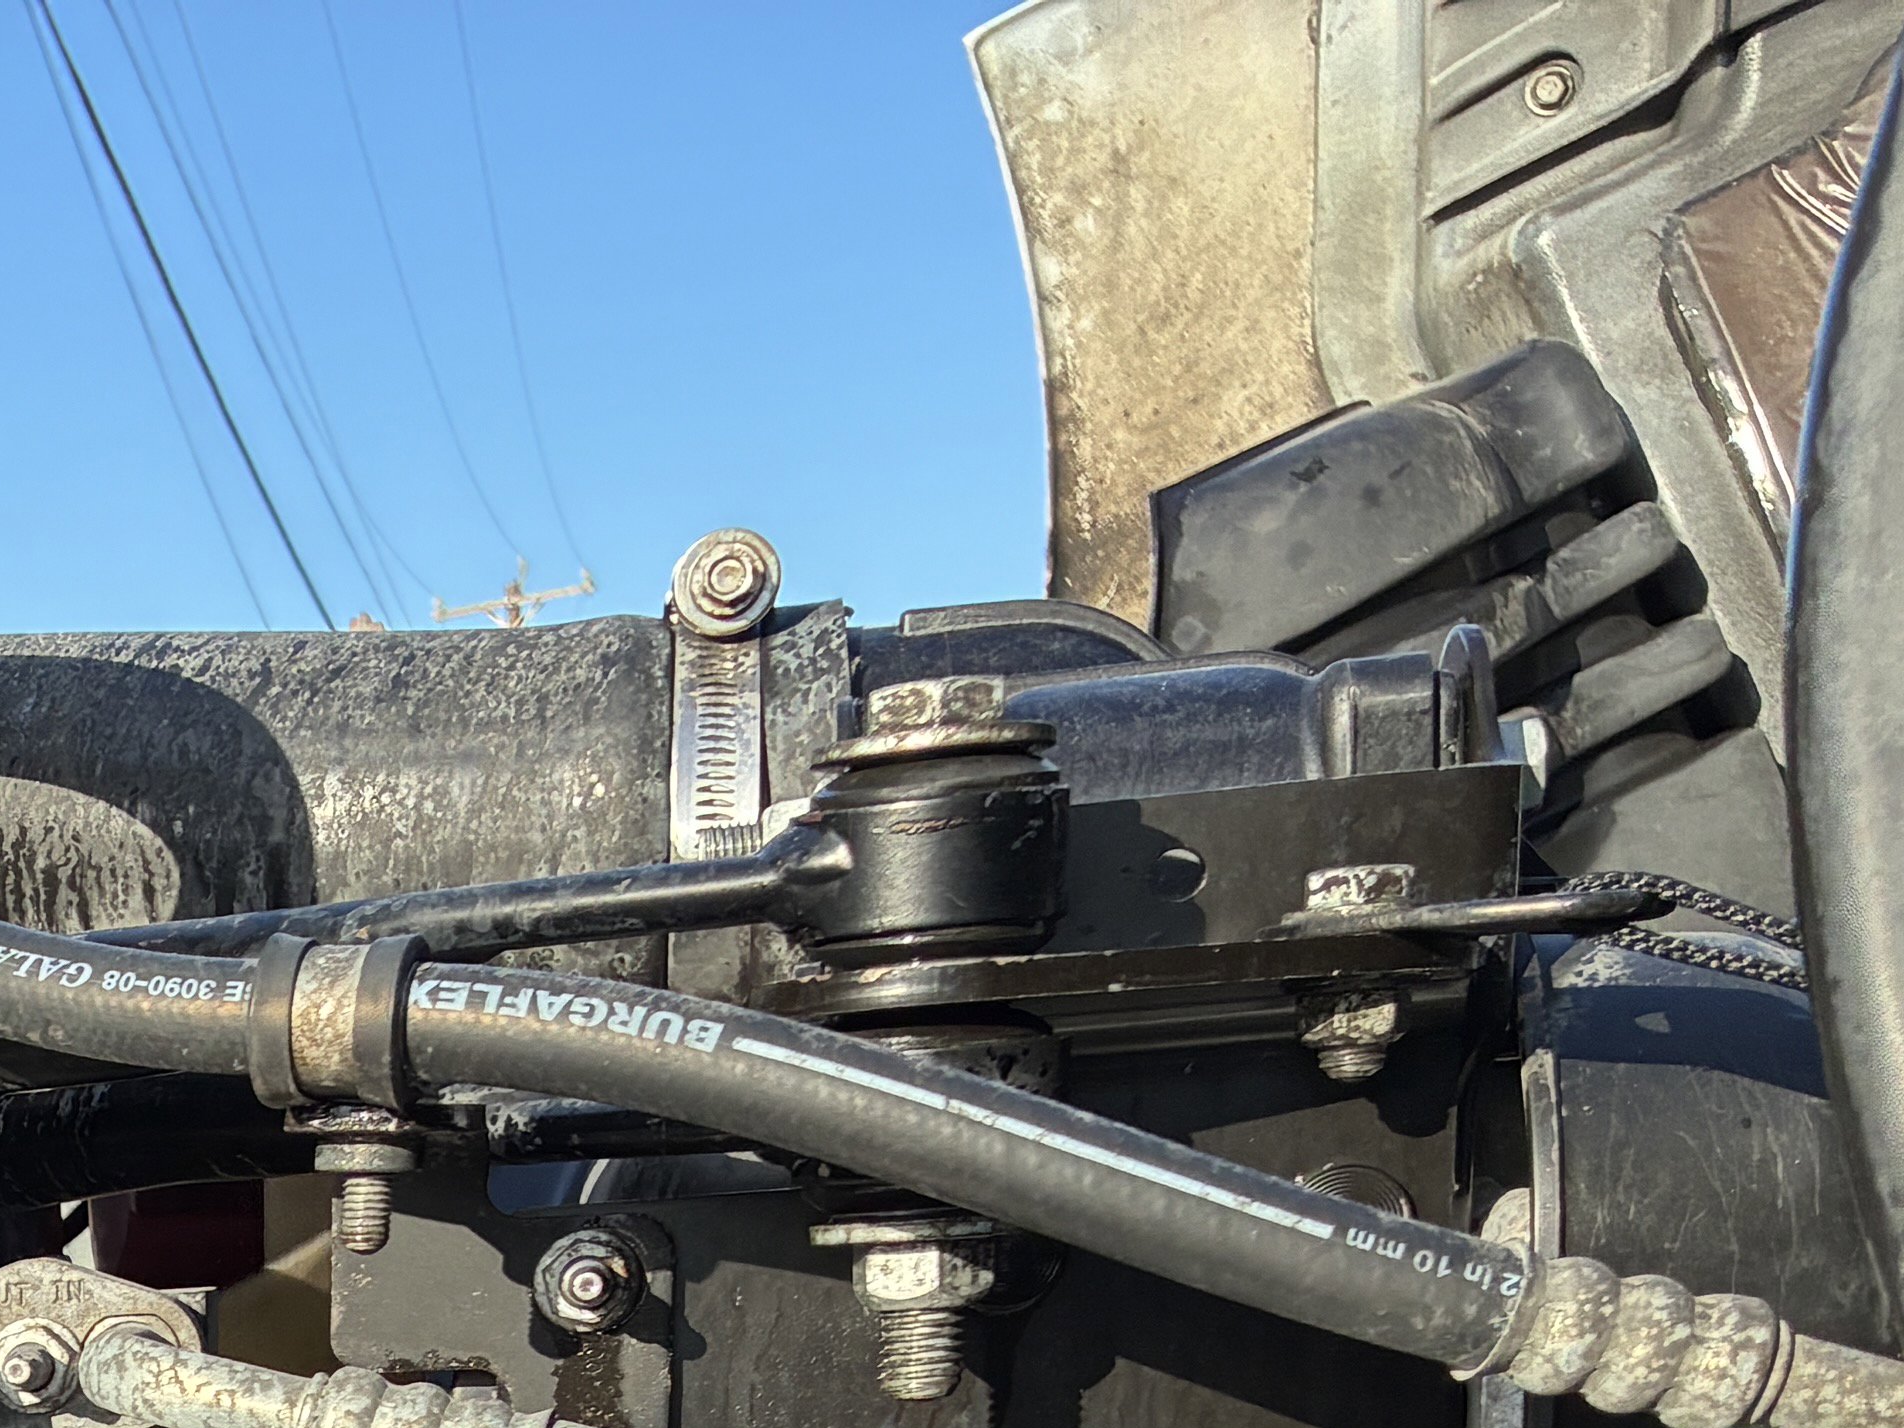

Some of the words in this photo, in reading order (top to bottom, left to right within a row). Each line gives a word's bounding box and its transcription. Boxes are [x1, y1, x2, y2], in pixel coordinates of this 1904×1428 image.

[101, 970, 218, 1000] 3090-08
[408, 978, 726, 1053] BURGAFLEX
[1344, 1226, 1408, 1261] mm
[1412, 1249, 1453, 1278] 10
[52, 1278, 86, 1304] IN
